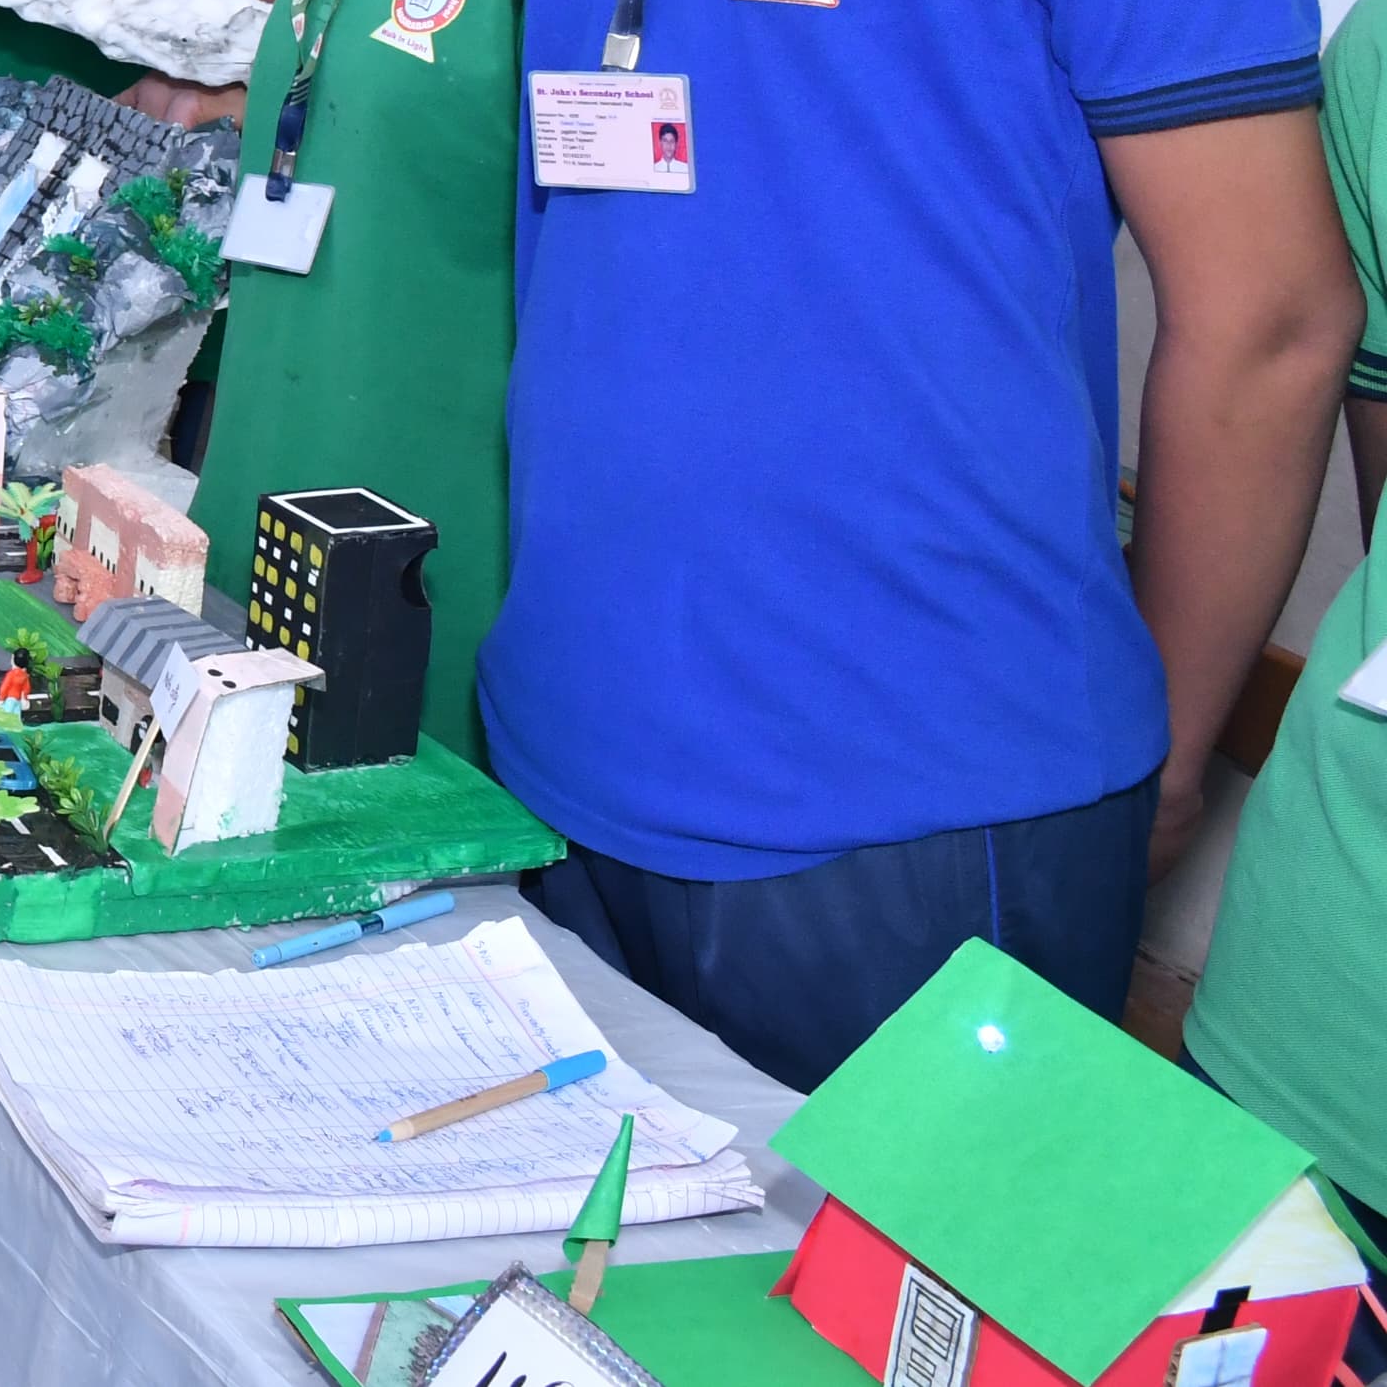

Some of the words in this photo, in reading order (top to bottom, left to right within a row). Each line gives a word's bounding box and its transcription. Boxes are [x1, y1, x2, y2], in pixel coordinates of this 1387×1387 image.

[550, 88, 577, 97] John's
[578, 88, 623, 99] Secondary
[624, 90, 654, 99] School
